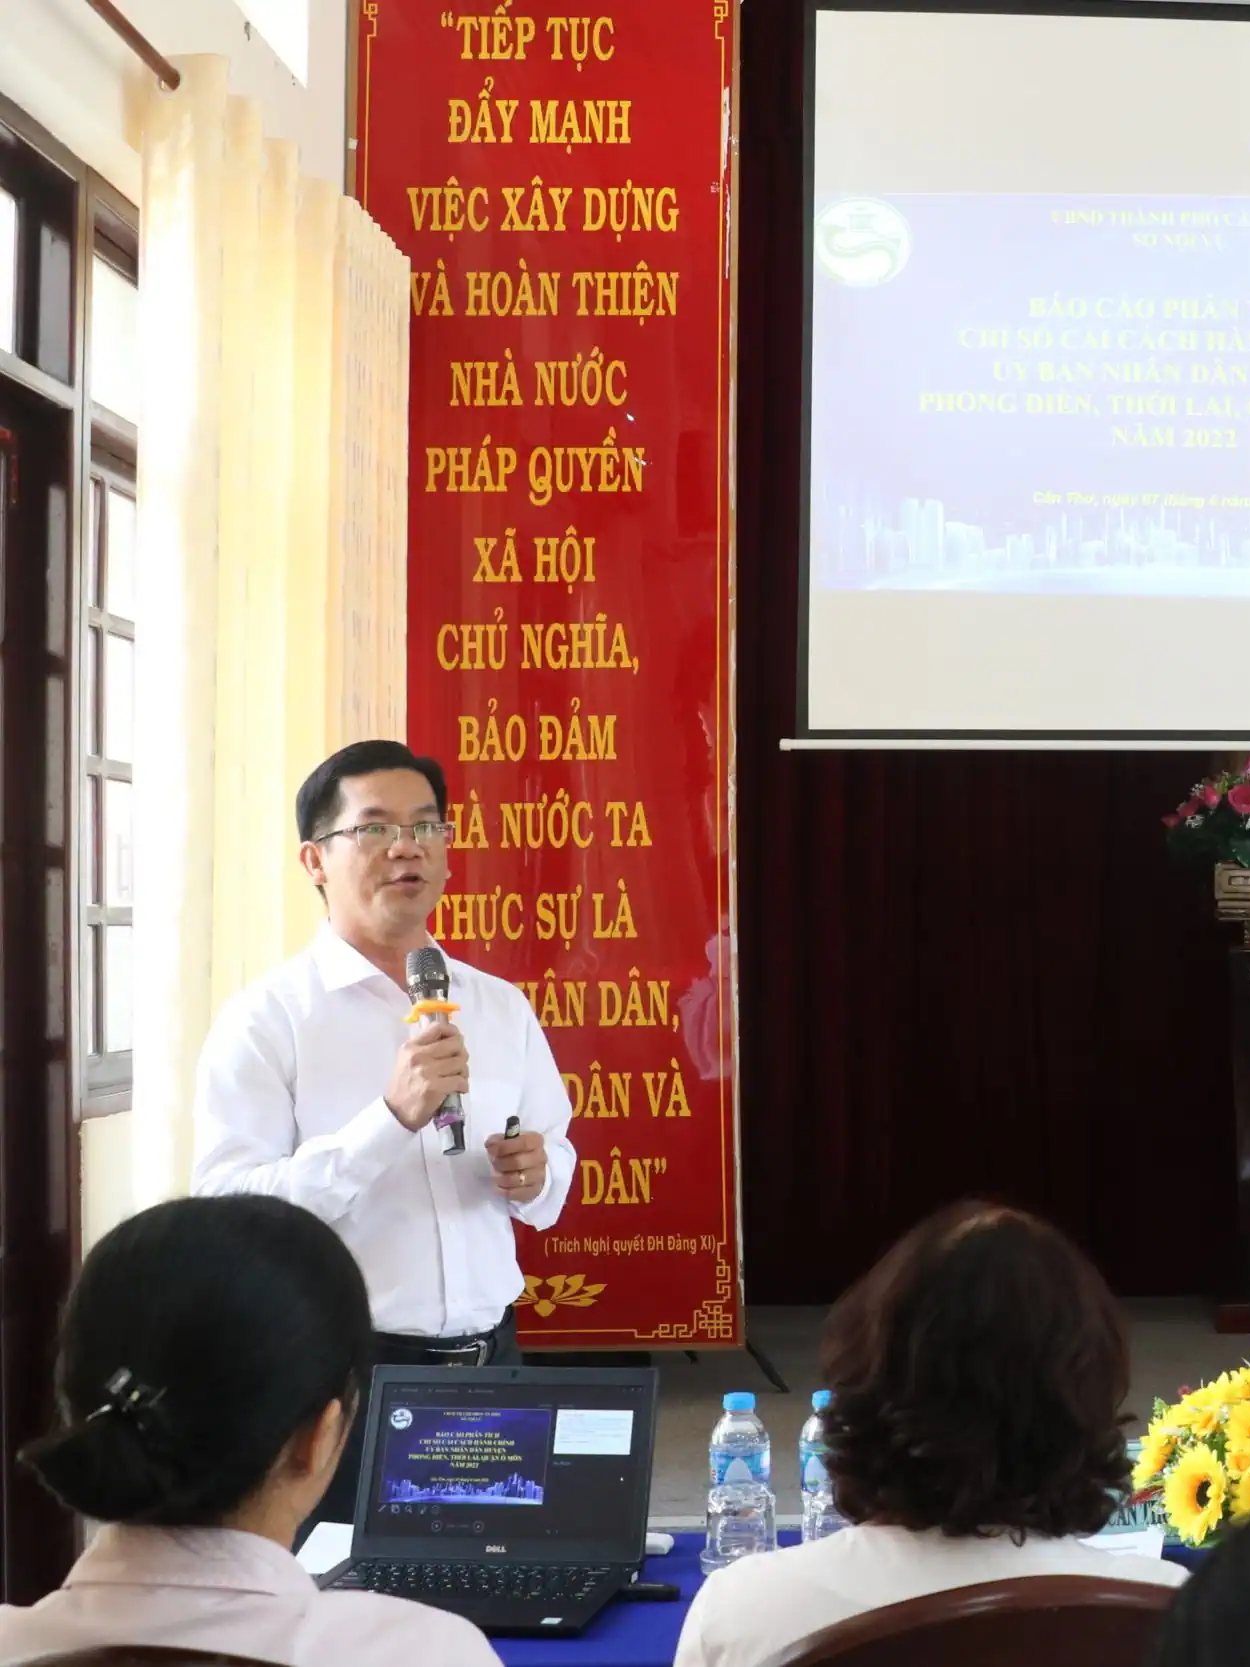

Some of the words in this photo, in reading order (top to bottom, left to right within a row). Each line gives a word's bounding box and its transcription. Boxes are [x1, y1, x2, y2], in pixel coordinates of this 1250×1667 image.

[546, 16, 615, 73] TỤC
[448, 77, 519, 144] ĐẨY
[530, 100, 632, 154] MẠNH
[407, 176, 489, 242] VIỆC
[500, 176, 573, 232] XÂY
[583, 179, 679, 242] DỰNG
[410, 258, 454, 317] VÀ
[465, 258, 561, 317] HOÀN
[571, 261, 679, 326] THIỆN
[450, 348, 523, 407] NHÀ
[534, 346, 629, 407] NƯỚC
[426, 434, 517, 492] PHÁP
[528, 427, 645, 506] QUYỀN
[1112, 420, 1176, 447] NĂM
[1183, 427, 1238, 449] 2022
[473, 528, 522, 583] XÃ
[534, 525, 596, 594] HỘI
[437, 607, 508, 671] CHỦ
[521, 613, 640, 674] NGHĨA,
[458, 698, 527, 762] BẢO
[539, 697, 617, 761] ĐẢM
[500, 788, 594, 849] NƯỚC
[606, 802, 653, 847] TA
[433, 885, 524, 951] THỰC
[536, 885, 582, 950] SỰ
[592, 878, 638, 939] LÀ
[599, 966, 680, 1033] DÂN,
[560, 1060, 632, 1118] DÂN
[643, 1057, 691, 1117] VÀ
[581, 1146, 667, 1205] DÂN”
[613, 1233, 644, 1256] quyết
[647, 1235, 664, 1251] ĐH
[667, 1232, 697, 1255] Đảng
[485, 1545, 507, 1553] DELL
